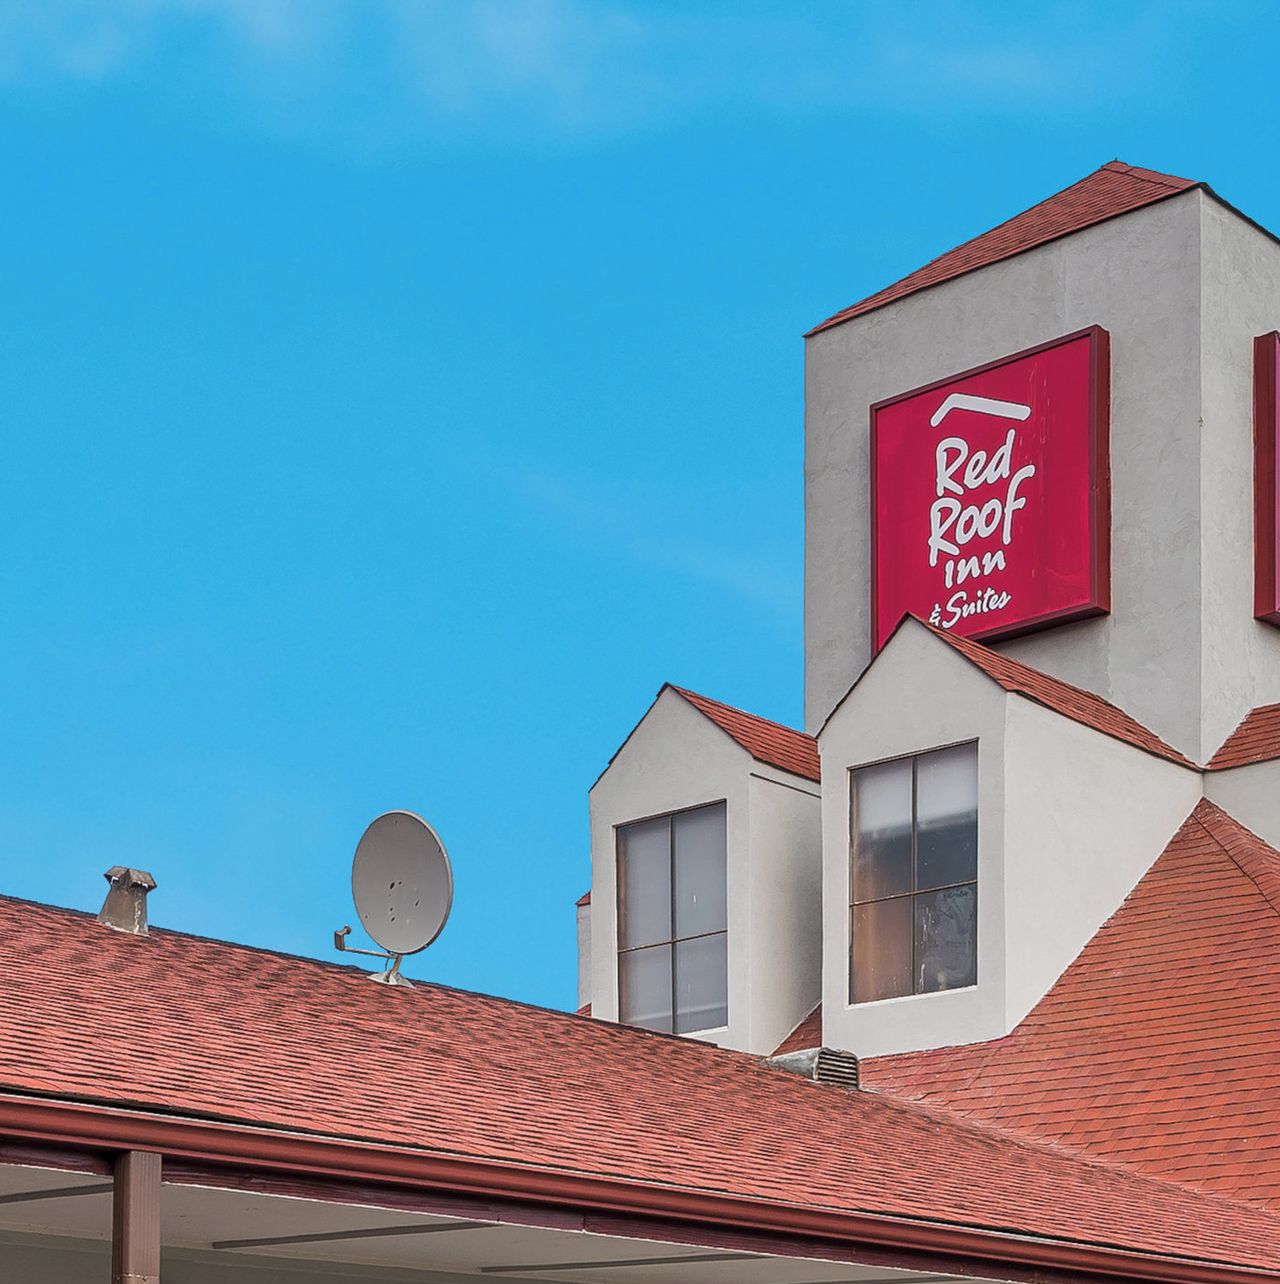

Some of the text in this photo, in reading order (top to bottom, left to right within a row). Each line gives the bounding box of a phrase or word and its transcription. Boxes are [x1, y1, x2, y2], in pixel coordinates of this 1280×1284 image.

[935, 428, 1016, 497] Red
[928, 464, 1035, 567] Roof
[942, 587, 1012, 629] Suites
